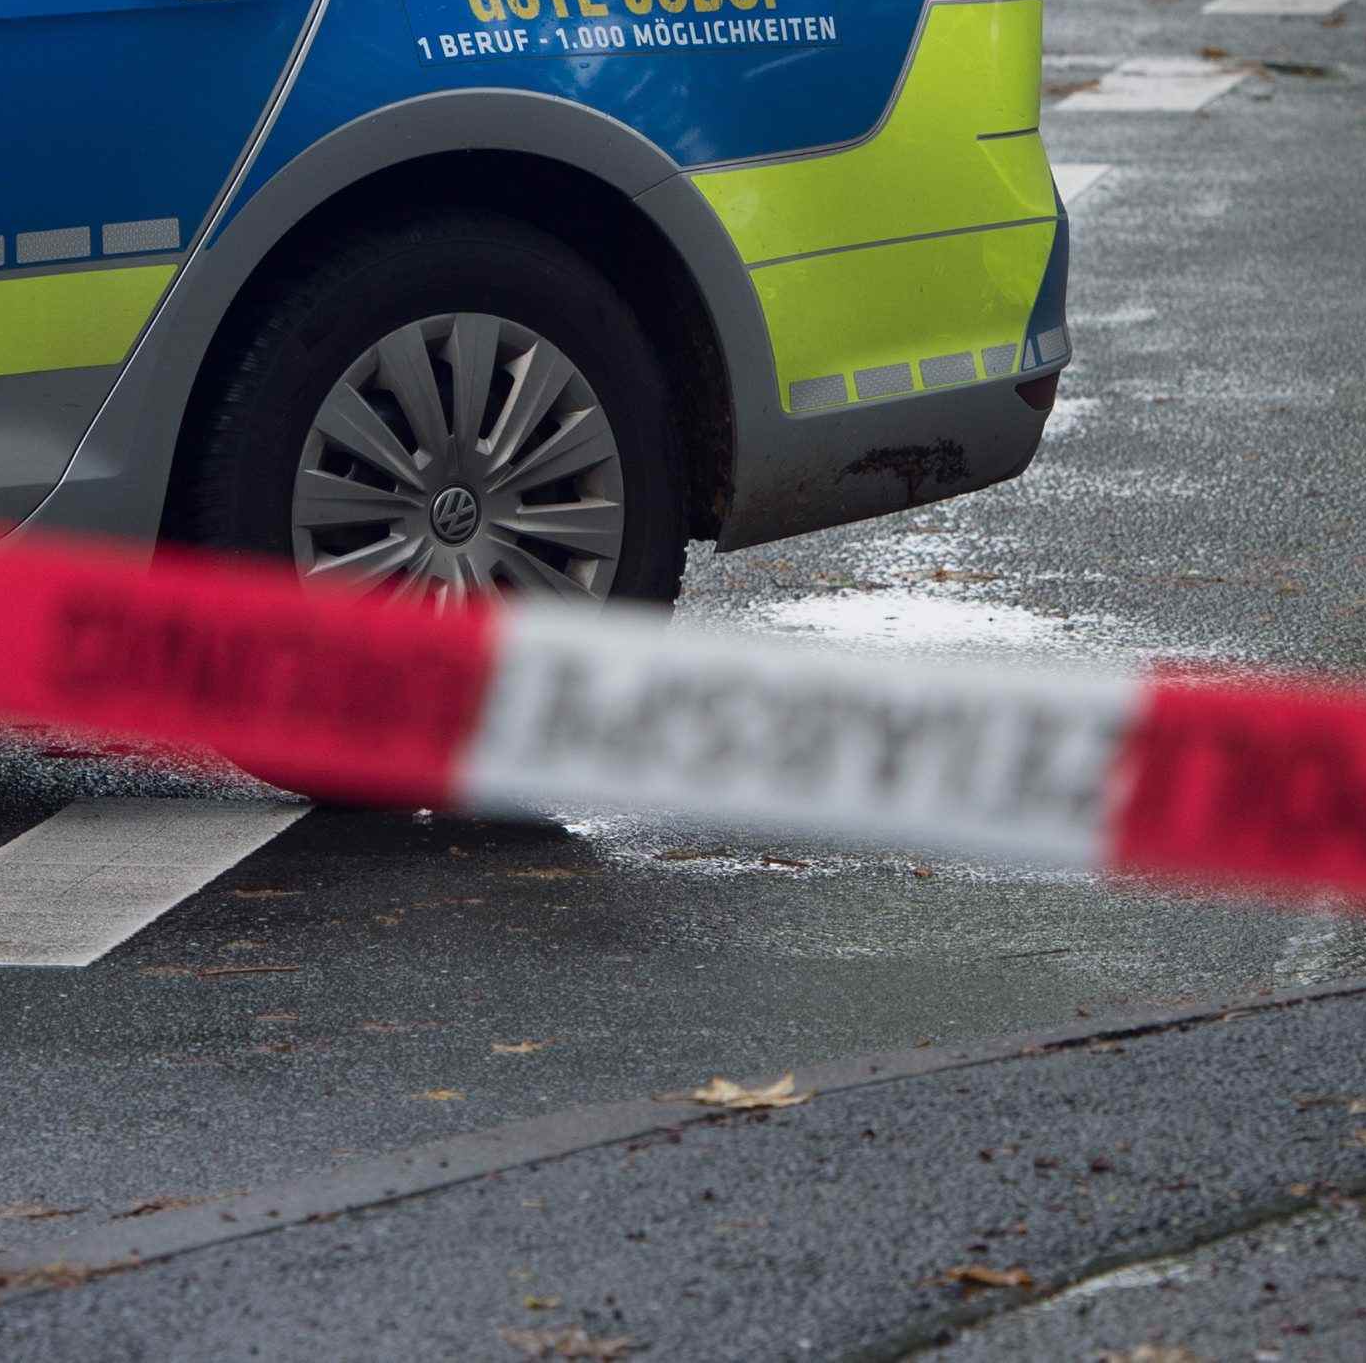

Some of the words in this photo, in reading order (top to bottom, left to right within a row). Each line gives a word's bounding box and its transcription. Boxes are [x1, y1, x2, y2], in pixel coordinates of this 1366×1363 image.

[418, 38, 433, 60] 1
[439, 29, 530, 58] BERUF
[556, 27, 625, 51] 1.000
[635, 16, 836, 47] MÖGLICHKEITEN
